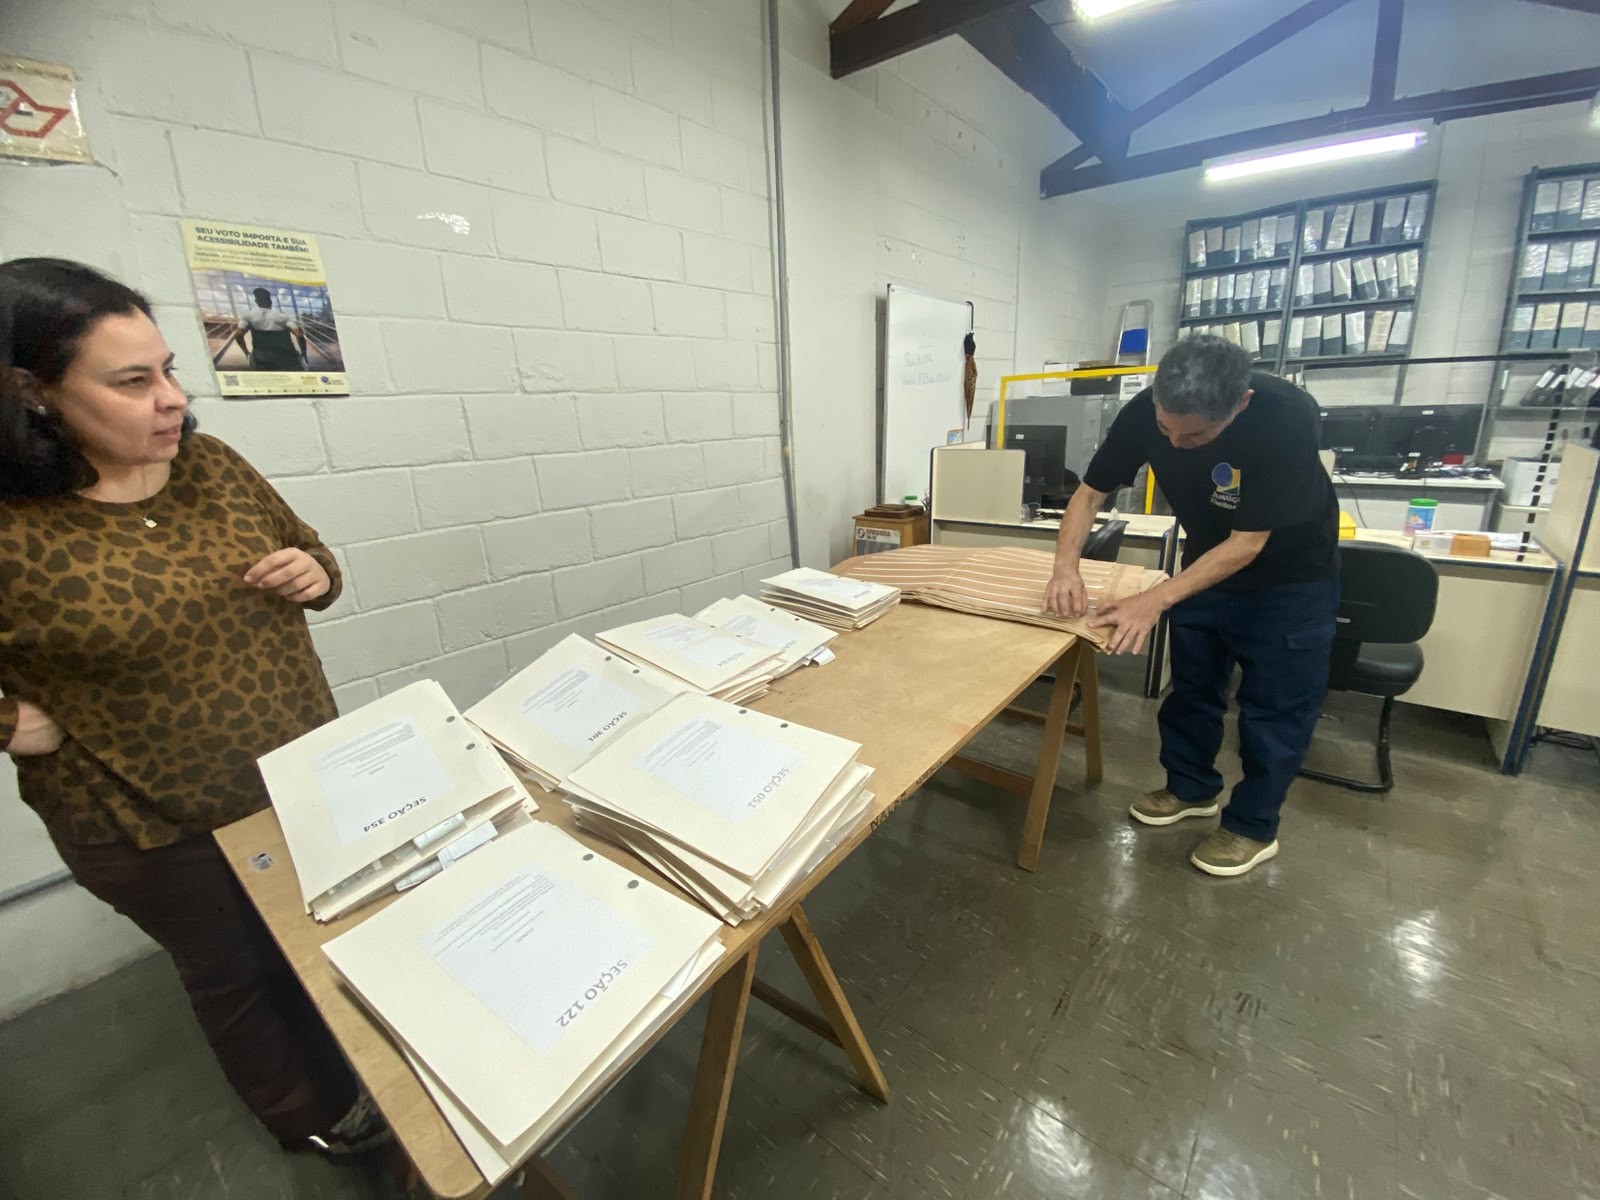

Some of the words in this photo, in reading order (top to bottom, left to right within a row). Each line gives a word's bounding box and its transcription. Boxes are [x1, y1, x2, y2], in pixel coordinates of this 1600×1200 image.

[195, 226, 214, 235] SEU
[215, 228, 241, 238] VOTO
[242, 232, 281, 243] IMPORTA
[291, 238, 307, 246] SUA
[197, 235, 270, 249] ACESSIBILIDADE
[388, 796, 426, 819] SEÇÃO
[747, 792, 766, 809] 051
[363, 817, 386, 832] 354
[584, 959, 628, 1001] SEÇÃO
[556, 1000, 586, 1028] 122
